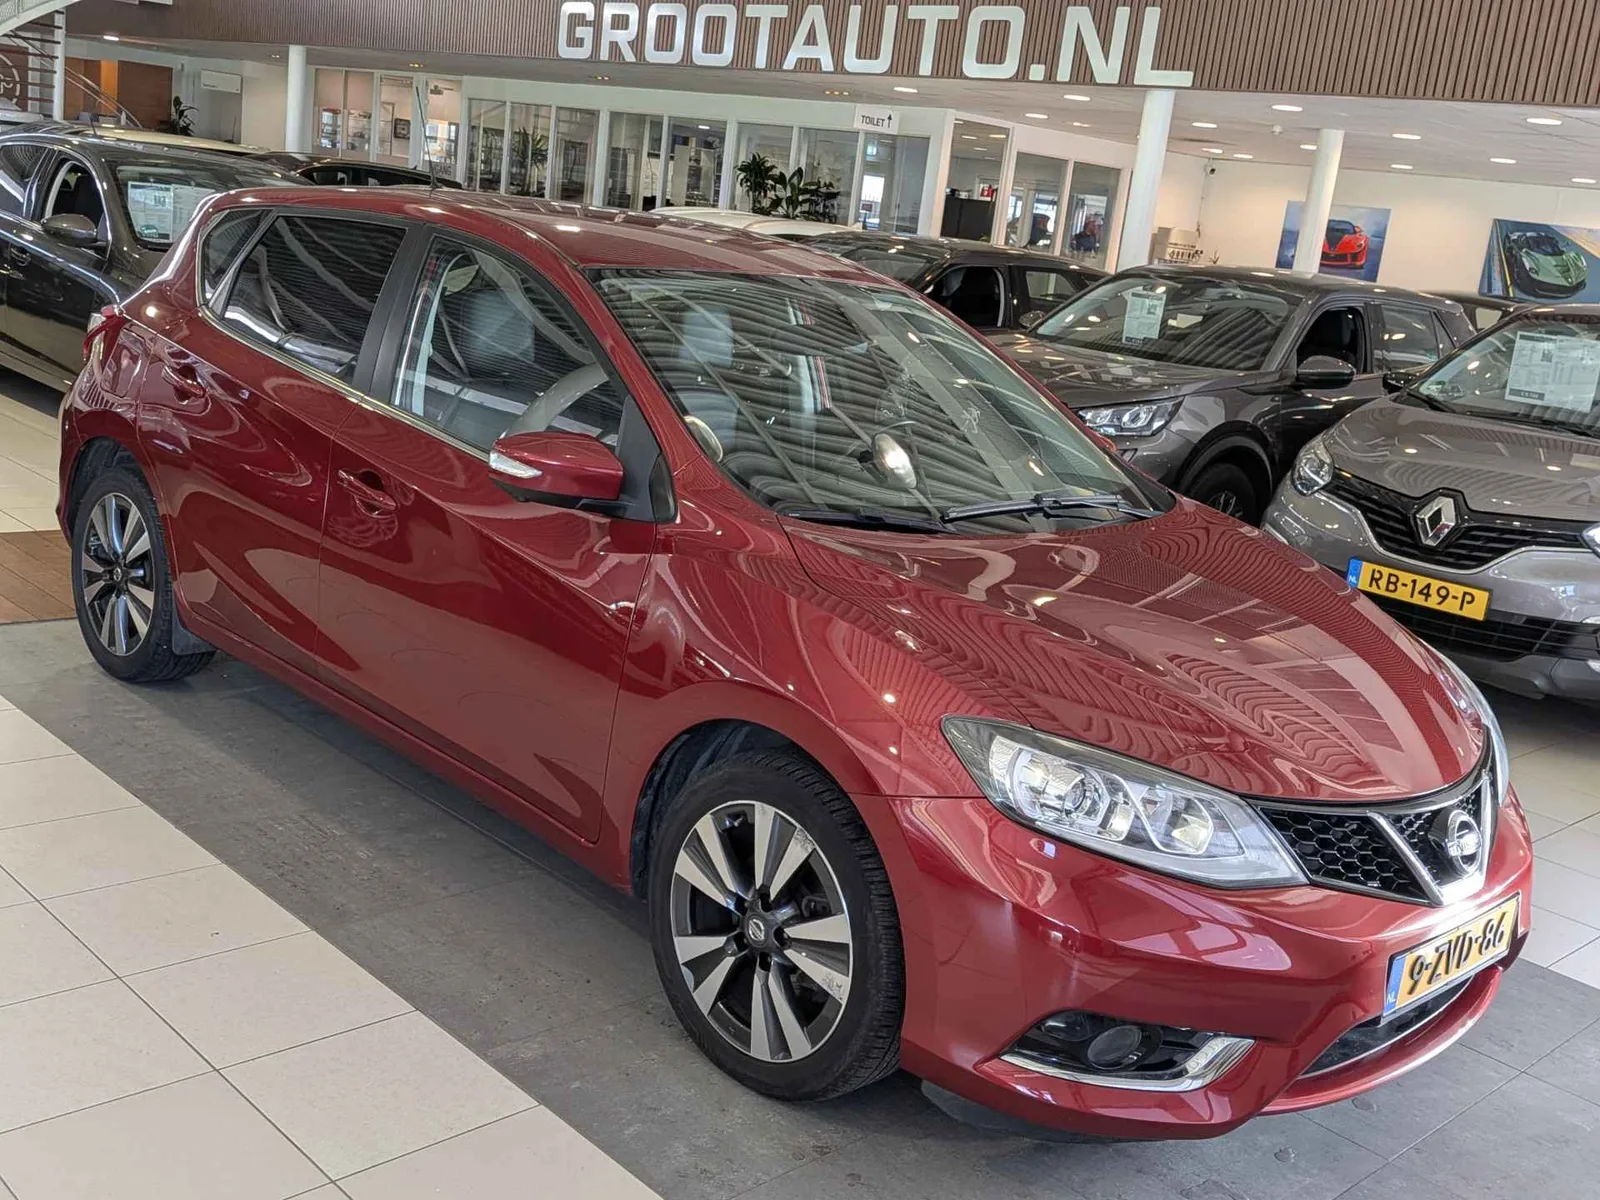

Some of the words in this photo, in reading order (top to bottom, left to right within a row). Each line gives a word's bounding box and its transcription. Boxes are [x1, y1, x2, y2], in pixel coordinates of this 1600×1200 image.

[558, 1, 1193, 86] GROOTAUTO.NL
[861, 114, 886, 127] TOILET
[1349, 574, 1358, 585] NL
[1368, 568, 1476, 612] RB-149-P
[1387, 991, 1396, 1004] NL
[1407, 911, 1507, 996] 9-ZVD-86
